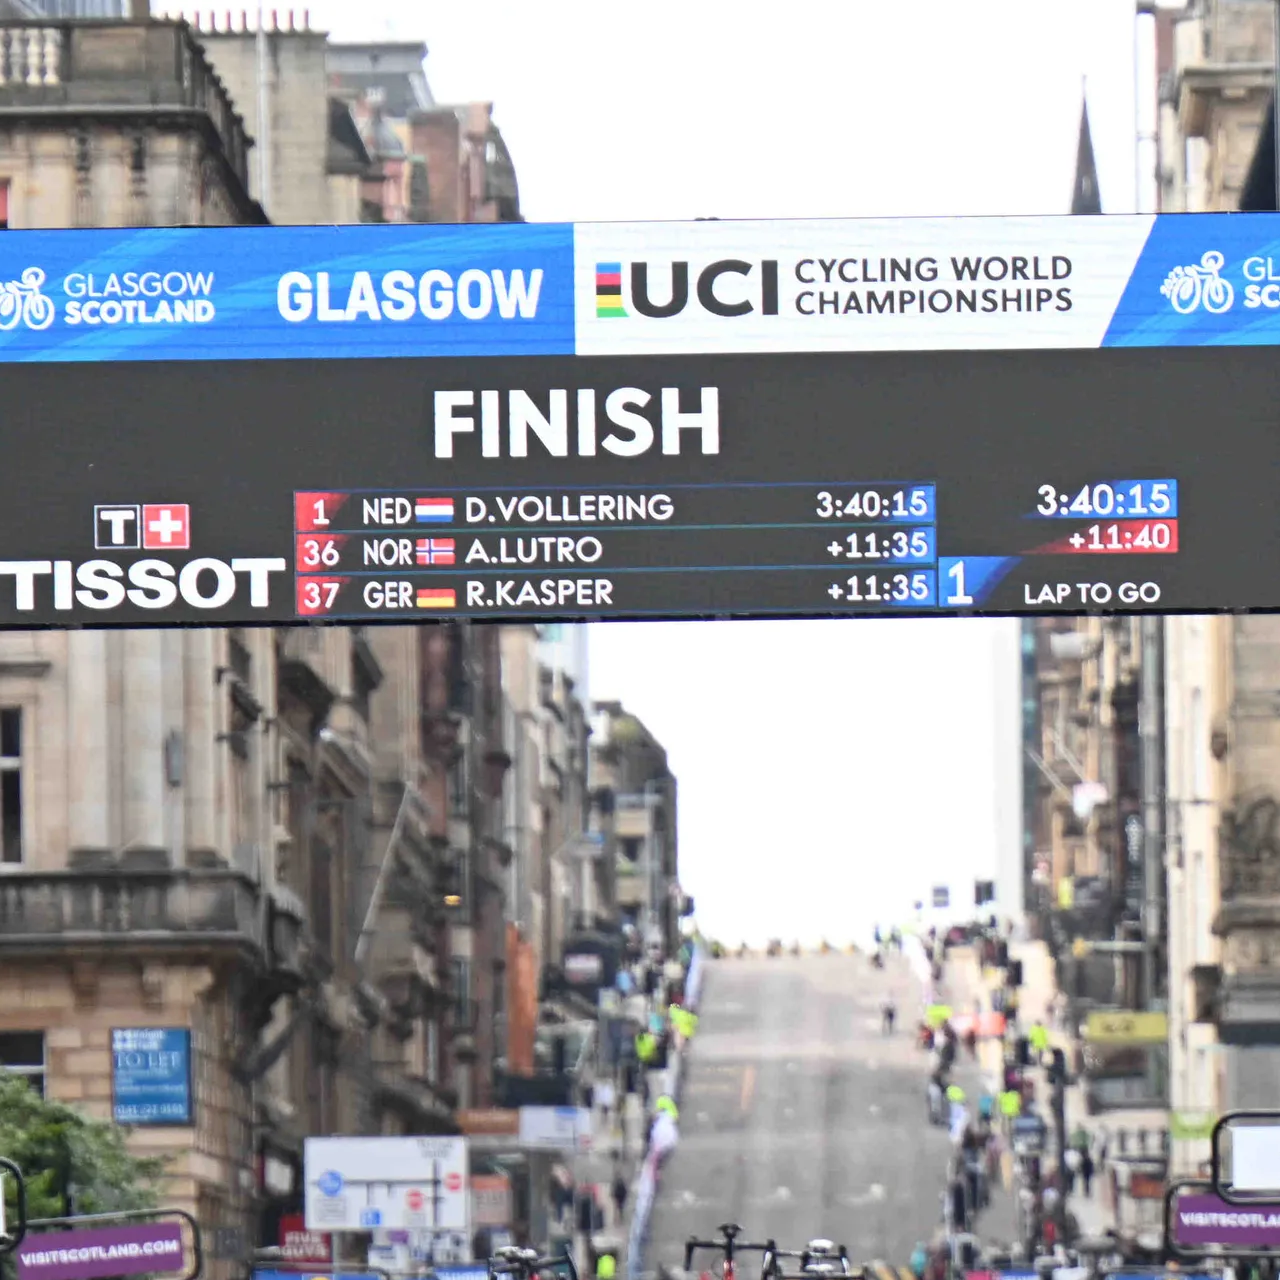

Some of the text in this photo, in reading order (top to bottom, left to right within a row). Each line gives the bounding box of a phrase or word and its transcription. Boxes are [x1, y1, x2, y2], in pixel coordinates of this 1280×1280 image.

[63, 271, 214, 298] GLASGOW
[796, 255, 1072, 284] CYCLING WORLD
[276, 268, 543, 321] GLASGOW
[631, 258, 779, 319] UCI
[796, 288, 1072, 314] CHAMPIONSHIPS
[64, 297, 215, 325] SCOTLAND
[434, 387, 719, 459] FINISH
[313, 491, 927, 525] 1 NED D.VOLLERING 3:40:15
[1037, 484, 1170, 515] 3:40:15
[303, 532, 928, 566] 36 NOR A.LUTRO +11:35
[1069, 523, 1170, 550] +11:40
[304, 574, 928, 608] 37 GER R.KASPER +11:35
[947, 561, 1161, 604] 1 LAP TO GO
[21, 1239, 179, 1267] VISITSCOTLAND.COM
